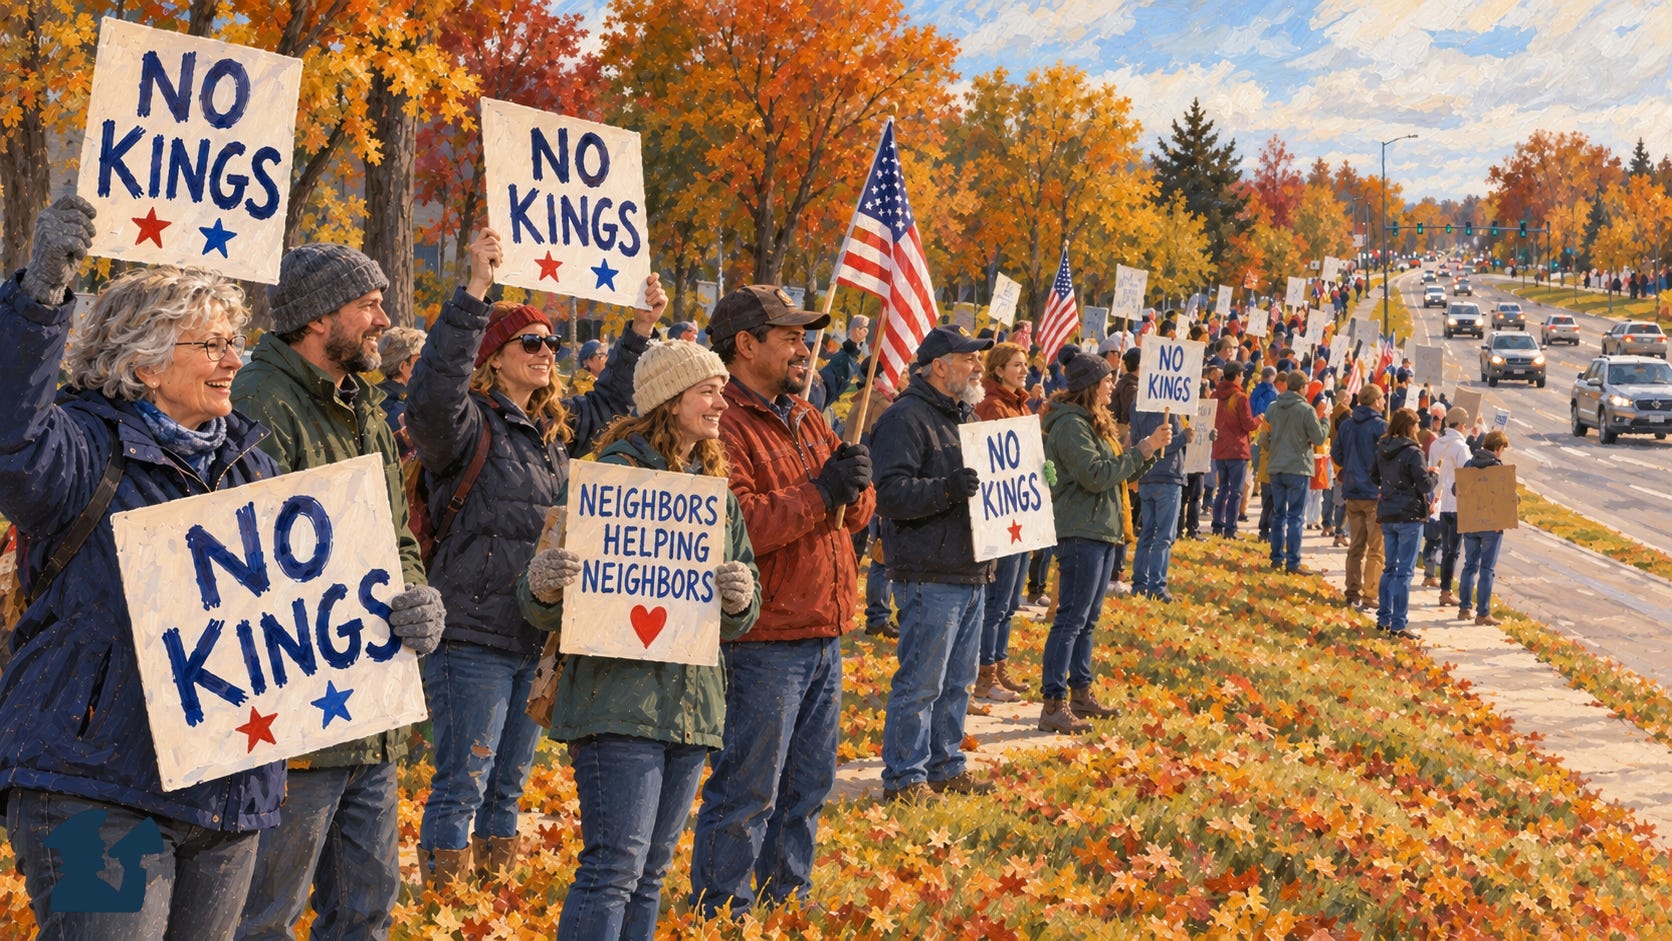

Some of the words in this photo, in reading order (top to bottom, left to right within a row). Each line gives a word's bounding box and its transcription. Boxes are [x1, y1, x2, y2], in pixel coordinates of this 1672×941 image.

[137, 50, 250, 129] NO
[98, 119, 281, 220] KINGS
[530, 127, 610, 188] NO
[508, 183, 641, 257] KINGS
[1159, 345, 1184, 372] NO
[1148, 373, 1191, 402] KINGS
[987, 429, 1020, 473] NO
[981, 472, 1042, 521] KINGS
[185, 495, 334, 611] NO
[603, 523, 710, 562] HELPING
[581, 559, 714, 603] NEIGHBORS
[161, 568, 402, 727] KINGS
